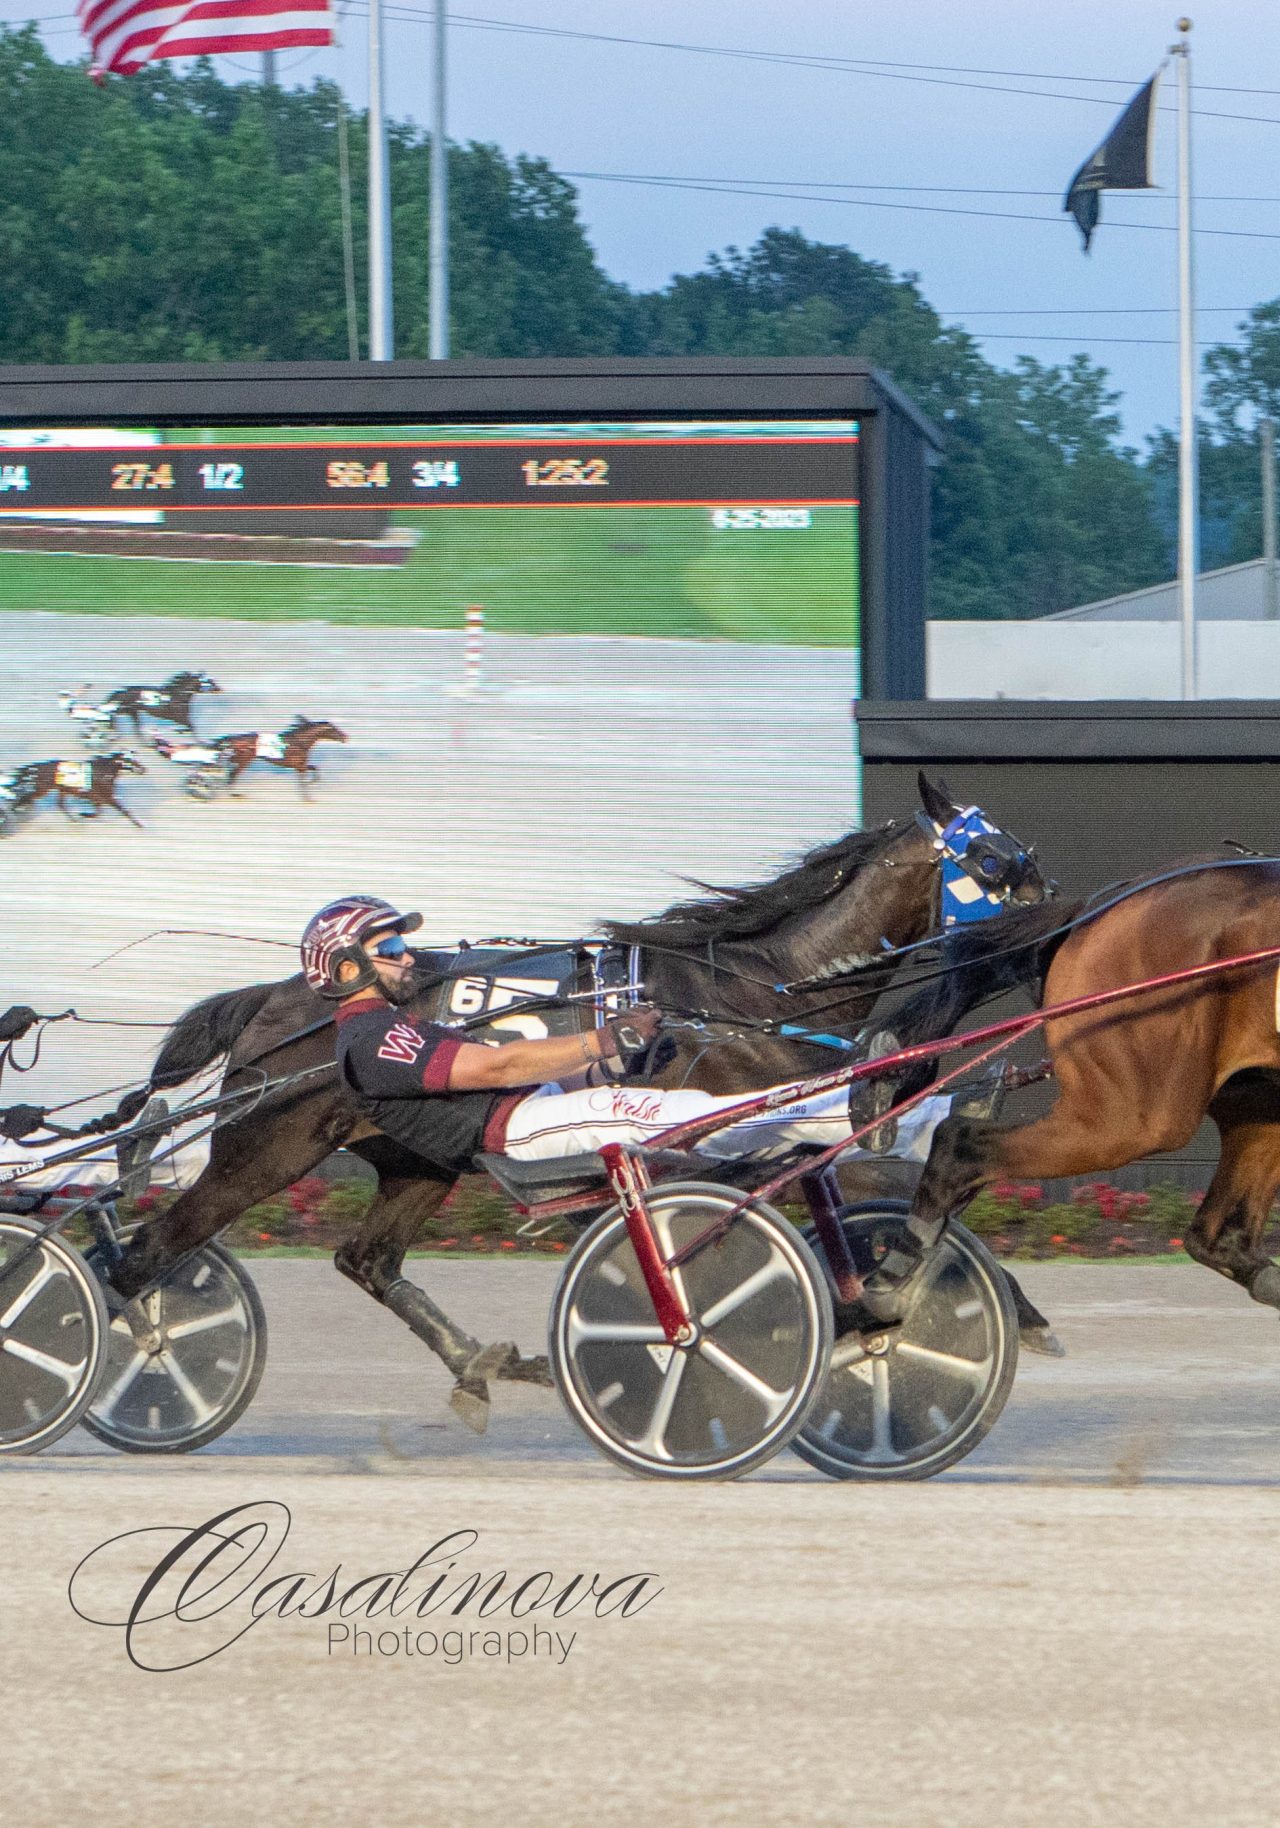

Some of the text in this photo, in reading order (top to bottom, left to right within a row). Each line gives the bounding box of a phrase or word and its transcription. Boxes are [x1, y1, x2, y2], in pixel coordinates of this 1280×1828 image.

[111, 463, 176, 489] 27:4
[199, 463, 244, 490] 1/2
[412, 461, 461, 487] 3/4
[450, 976, 488, 1015] 6
[377, 1022, 426, 1065] W
